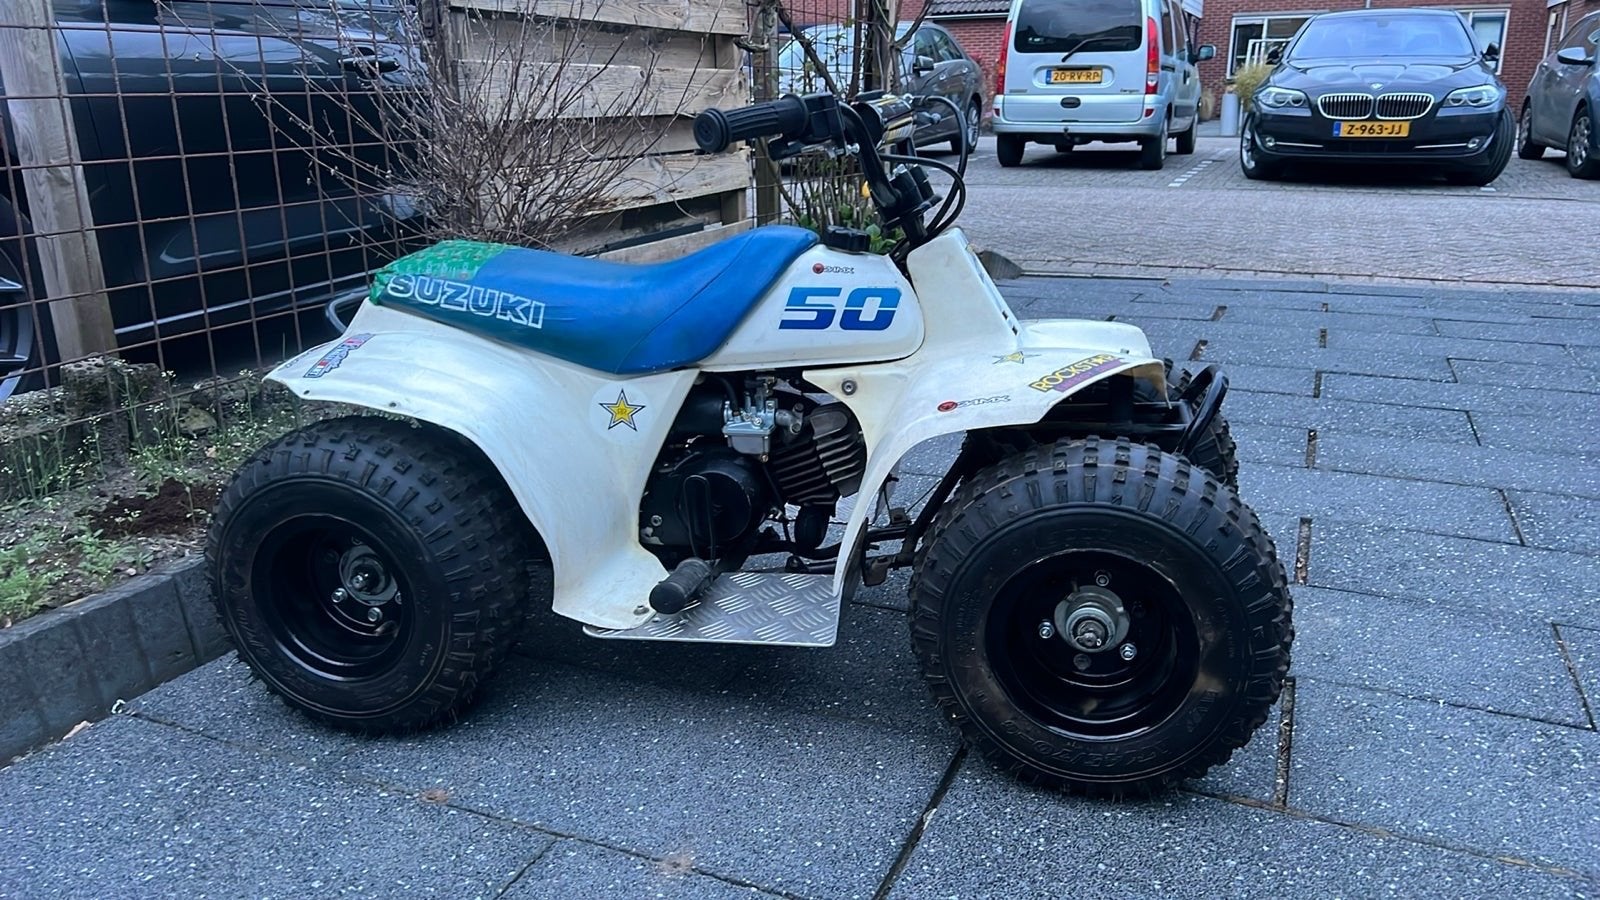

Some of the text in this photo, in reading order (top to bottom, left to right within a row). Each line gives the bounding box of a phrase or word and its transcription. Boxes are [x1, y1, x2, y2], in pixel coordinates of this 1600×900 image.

[1053, 71, 1100, 81] 20-RV-RP
[1346, 124, 1403, 135] Z-963-JJ
[387, 274, 545, 329] SUZUKI
[779, 287, 902, 331] 50
